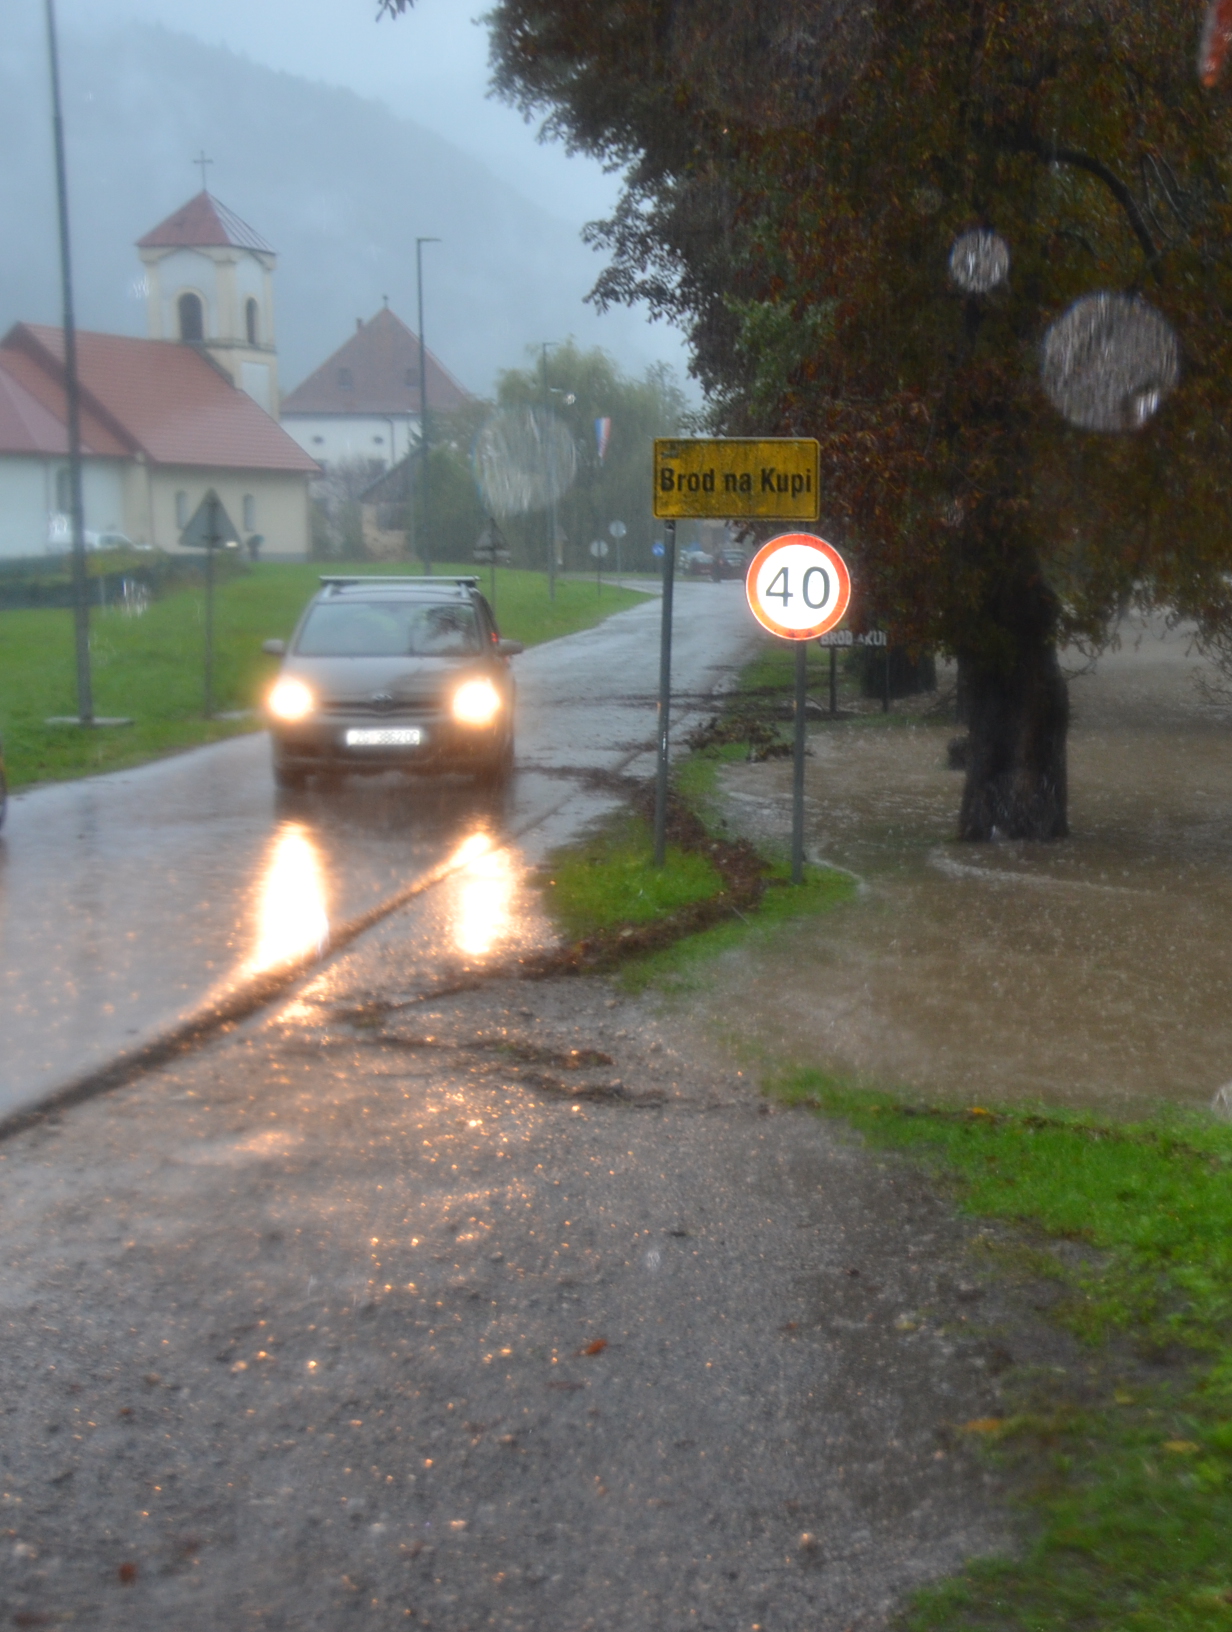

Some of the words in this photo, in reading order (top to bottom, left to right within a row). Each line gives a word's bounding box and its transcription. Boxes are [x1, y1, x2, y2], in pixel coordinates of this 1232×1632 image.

[660, 468, 715, 492] Brod
[724, 472, 752, 492] na
[761, 467, 811, 498] Kupi
[766, 566, 830, 609] 40
[820, 629, 853, 646] BROD
